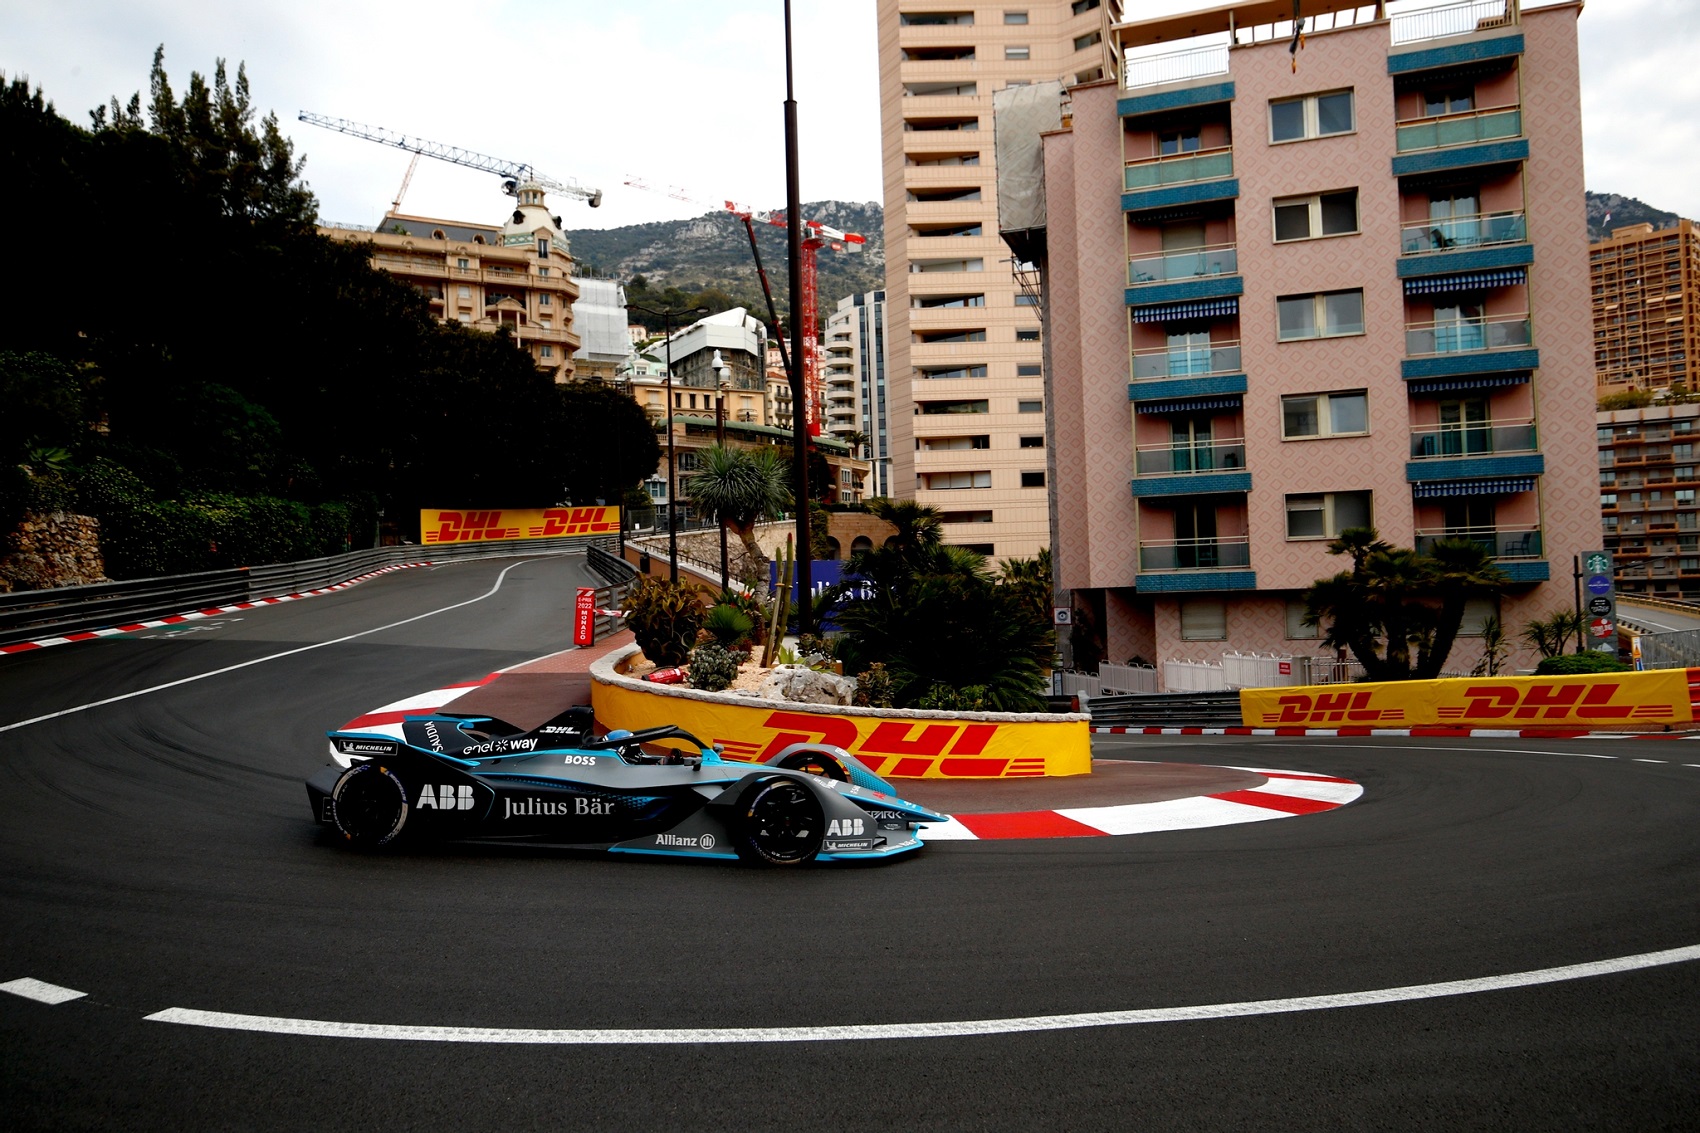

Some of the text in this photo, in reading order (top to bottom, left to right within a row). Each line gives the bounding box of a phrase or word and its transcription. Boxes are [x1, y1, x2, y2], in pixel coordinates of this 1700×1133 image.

[437, 511, 507, 541] DHL
[542, 507, 610, 535] DHL
[580, 610, 588, 640] MONACO
[1277, 692, 1384, 722] DHL
[1460, 684, 1634, 720] DHL
[546, 726, 575, 735] DHL
[354, 744, 393, 752] MICHELIN
[463, 737, 538, 755] enel way
[756, 711, 1010, 777] DHL
[565, 755, 596, 766] BOSS
[416, 784, 475, 810] ABB
[504, 797, 615, 820] Julius Bär
[826, 819, 864, 836] ABB
[655, 833, 698, 847] Allianz
